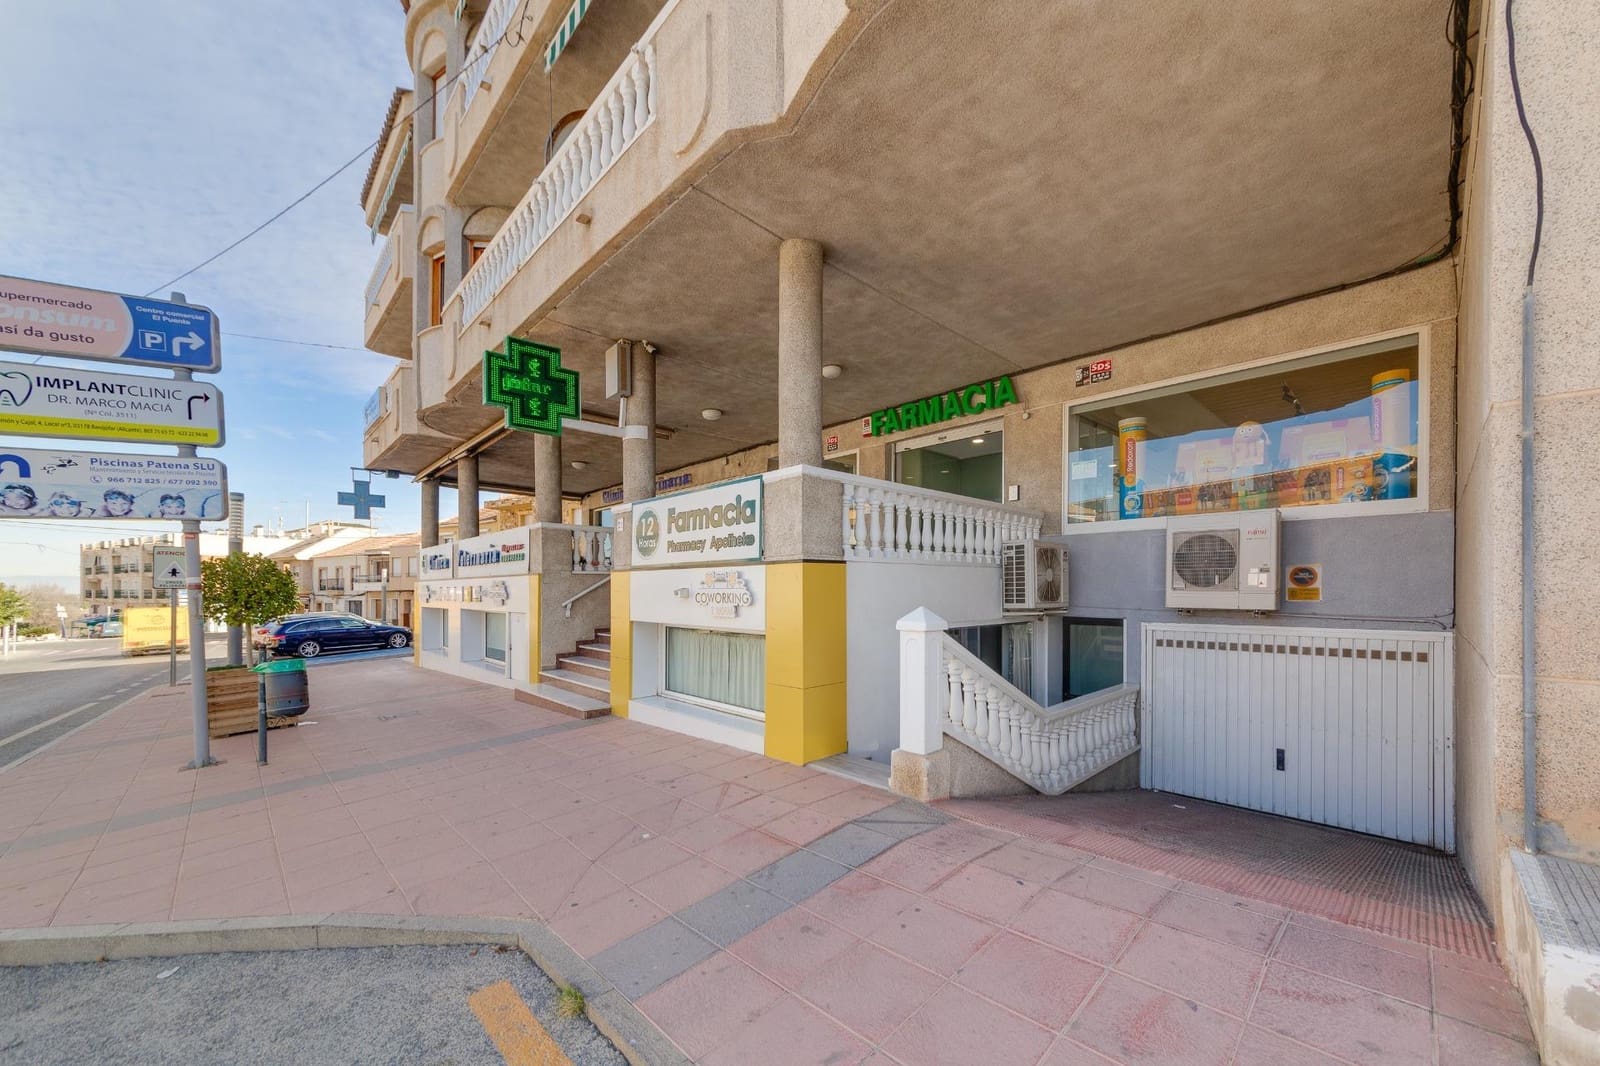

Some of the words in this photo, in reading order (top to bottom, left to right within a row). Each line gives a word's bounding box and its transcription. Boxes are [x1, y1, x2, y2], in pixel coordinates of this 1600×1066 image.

[136, 305, 164, 316] Centro
[166, 312, 204, 320] comercial
[162, 316, 191, 325] Puente
[24, 326, 44, 338] da
[50, 332, 94, 344] gusto
[1092, 362, 1110, 372] SDS
[36, 376, 183, 400] IMPLANTCLINIC
[48, 394, 72, 404] DR.
[76, 396, 126, 409] MARCO
[871, 376, 1017, 437] FARMACIA
[90, 458, 144, 468] Piscinas
[147, 461, 190, 470] Patena
[193, 462, 215, 471] SLU
[667, 494, 756, 534] Farmacia
[642, 516, 654, 536] 12
[667, 539, 706, 553] Pharmacy
[695, 592, 750, 604] COWORKING
